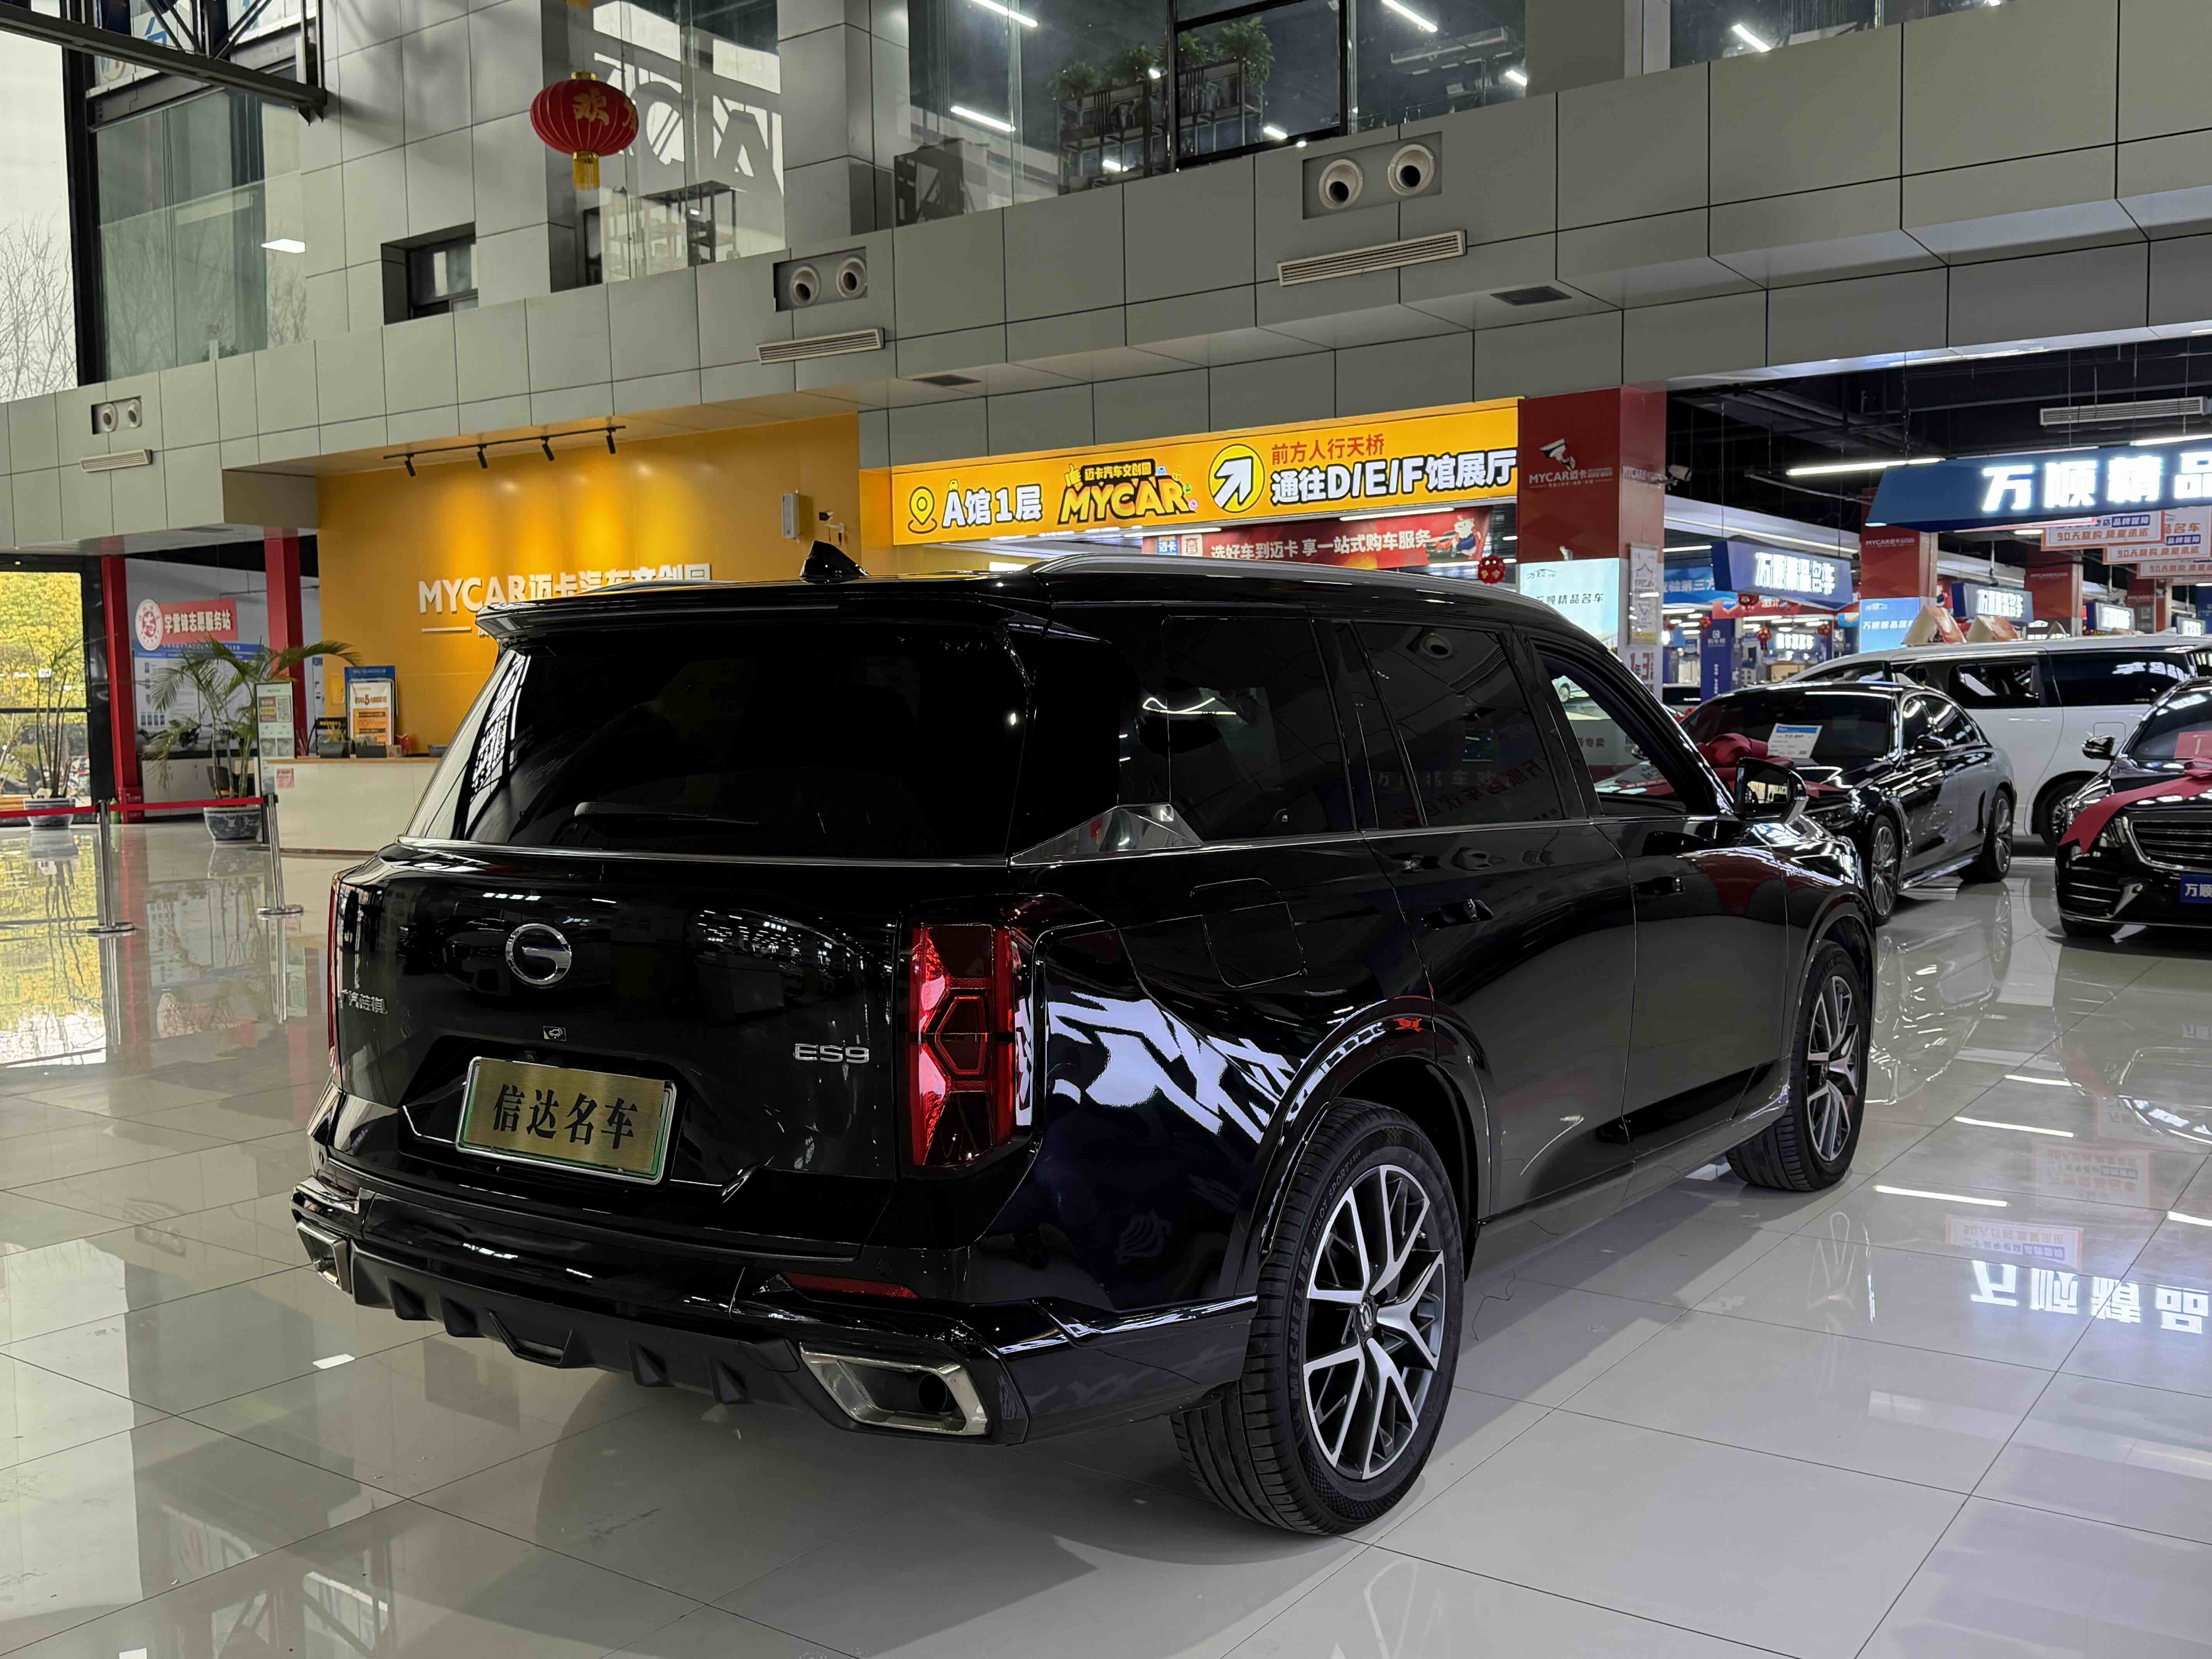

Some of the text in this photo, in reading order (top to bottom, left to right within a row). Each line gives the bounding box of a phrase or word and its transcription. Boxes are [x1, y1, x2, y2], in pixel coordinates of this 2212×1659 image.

[1085, 462, 1152, 480] 迈卡汽车文创园
[1272, 434, 1384, 465] 前方人行天桥
[1271, 449, 1516, 504] 通往D/E/F馆展厅
[1982, 452, 2212, 511] 万顺精品
[942, 484, 1042, 527] A馆1层
[1059, 479, 1192, 523] MYCAR
[1211, 529, 1431, 559] 选好车到迈卡 享一站式购车服务
[794, 1043, 869, 1064] ES9
[493, 1084, 638, 1149] 信达名车
[1312, 1198, 1328, 1238] PILOT
[1328, 1163, 1350, 1200] SPORT
[1288, 1247, 1311, 1400] MICHELIN
